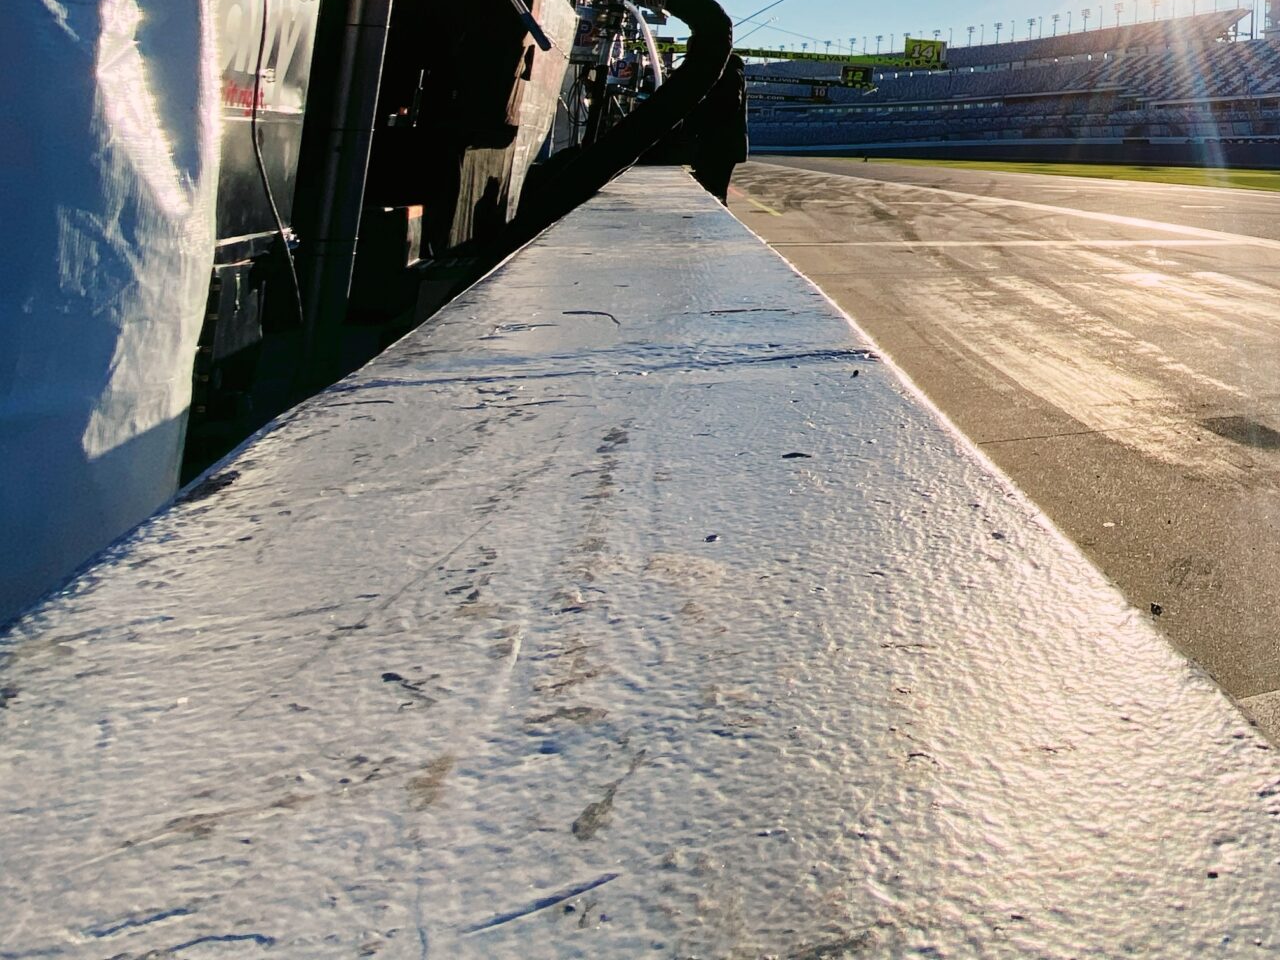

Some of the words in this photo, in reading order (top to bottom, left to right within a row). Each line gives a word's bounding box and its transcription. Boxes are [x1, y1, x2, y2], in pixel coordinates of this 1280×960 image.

[794, 50, 850, 62] SULLIVAN
[911, 43, 935, 59] 14
[846, 71, 864, 81] 12
[814, 88, 826, 97] 10
